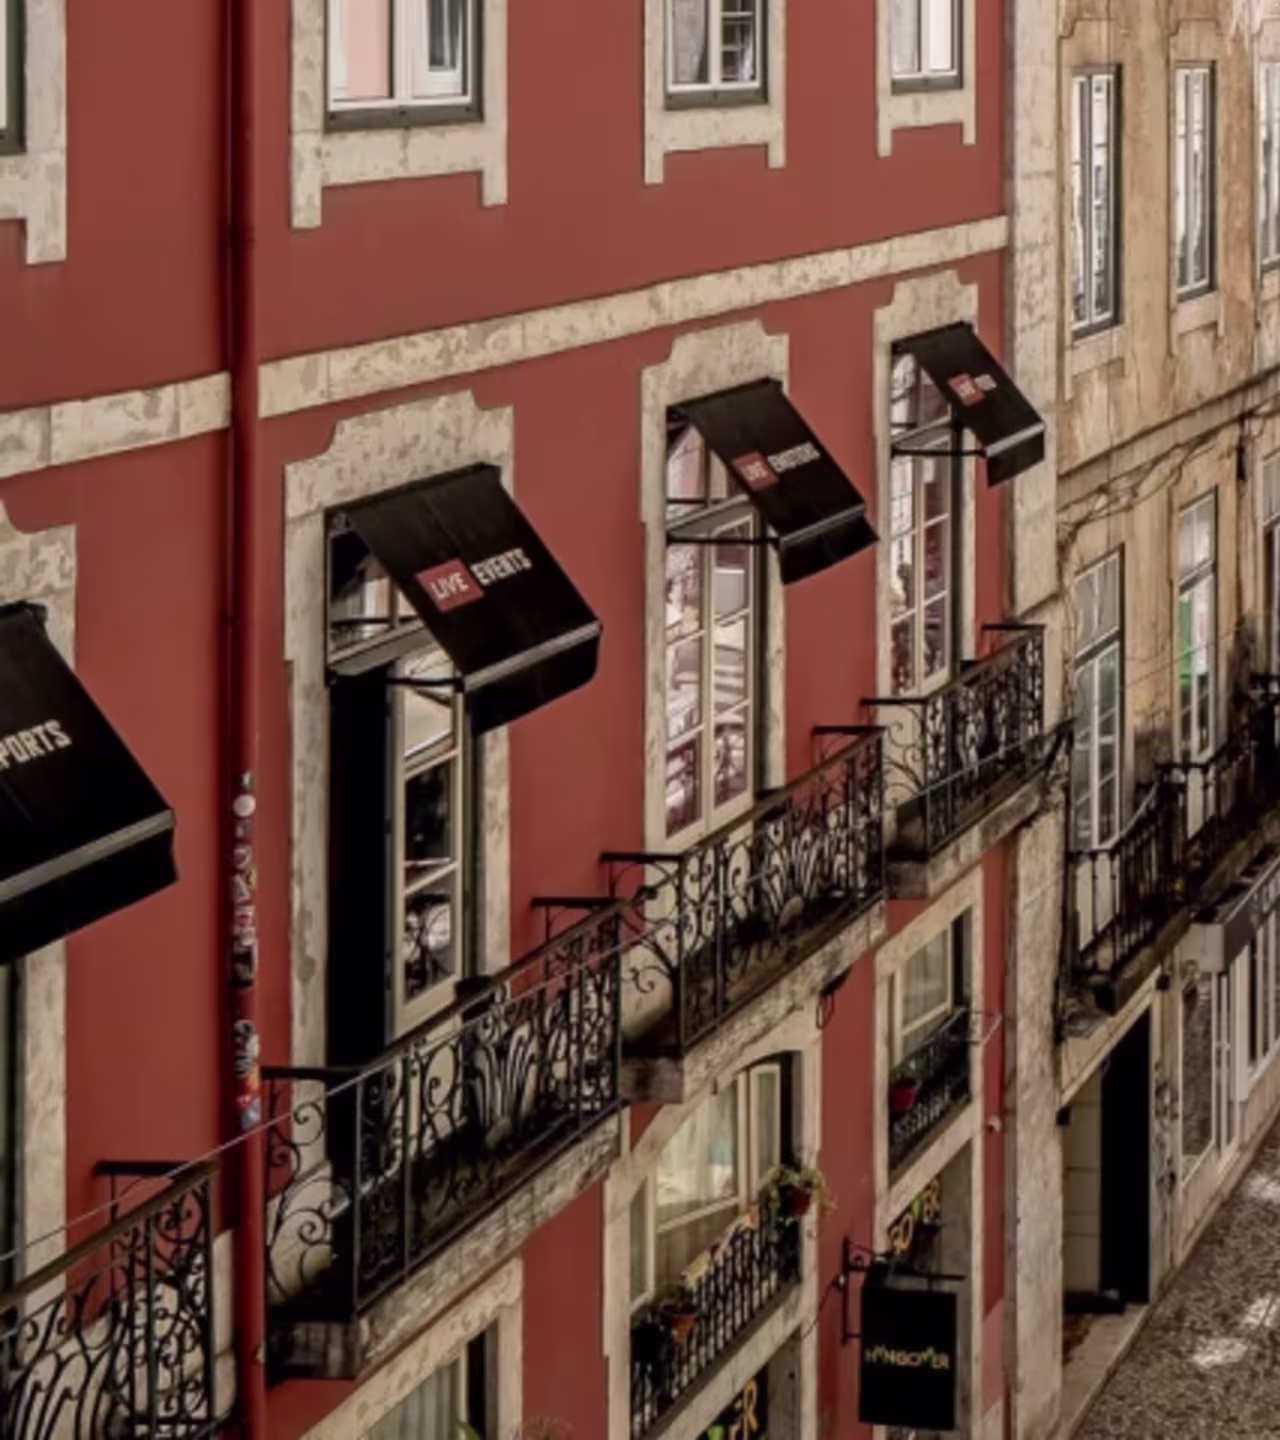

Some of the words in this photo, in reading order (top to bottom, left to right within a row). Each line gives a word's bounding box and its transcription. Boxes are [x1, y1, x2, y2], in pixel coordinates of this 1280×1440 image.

[430, 571, 470, 600] LIVE
[470, 547, 533, 586] EVENTS
[0, 719, 73, 772] PORTS
